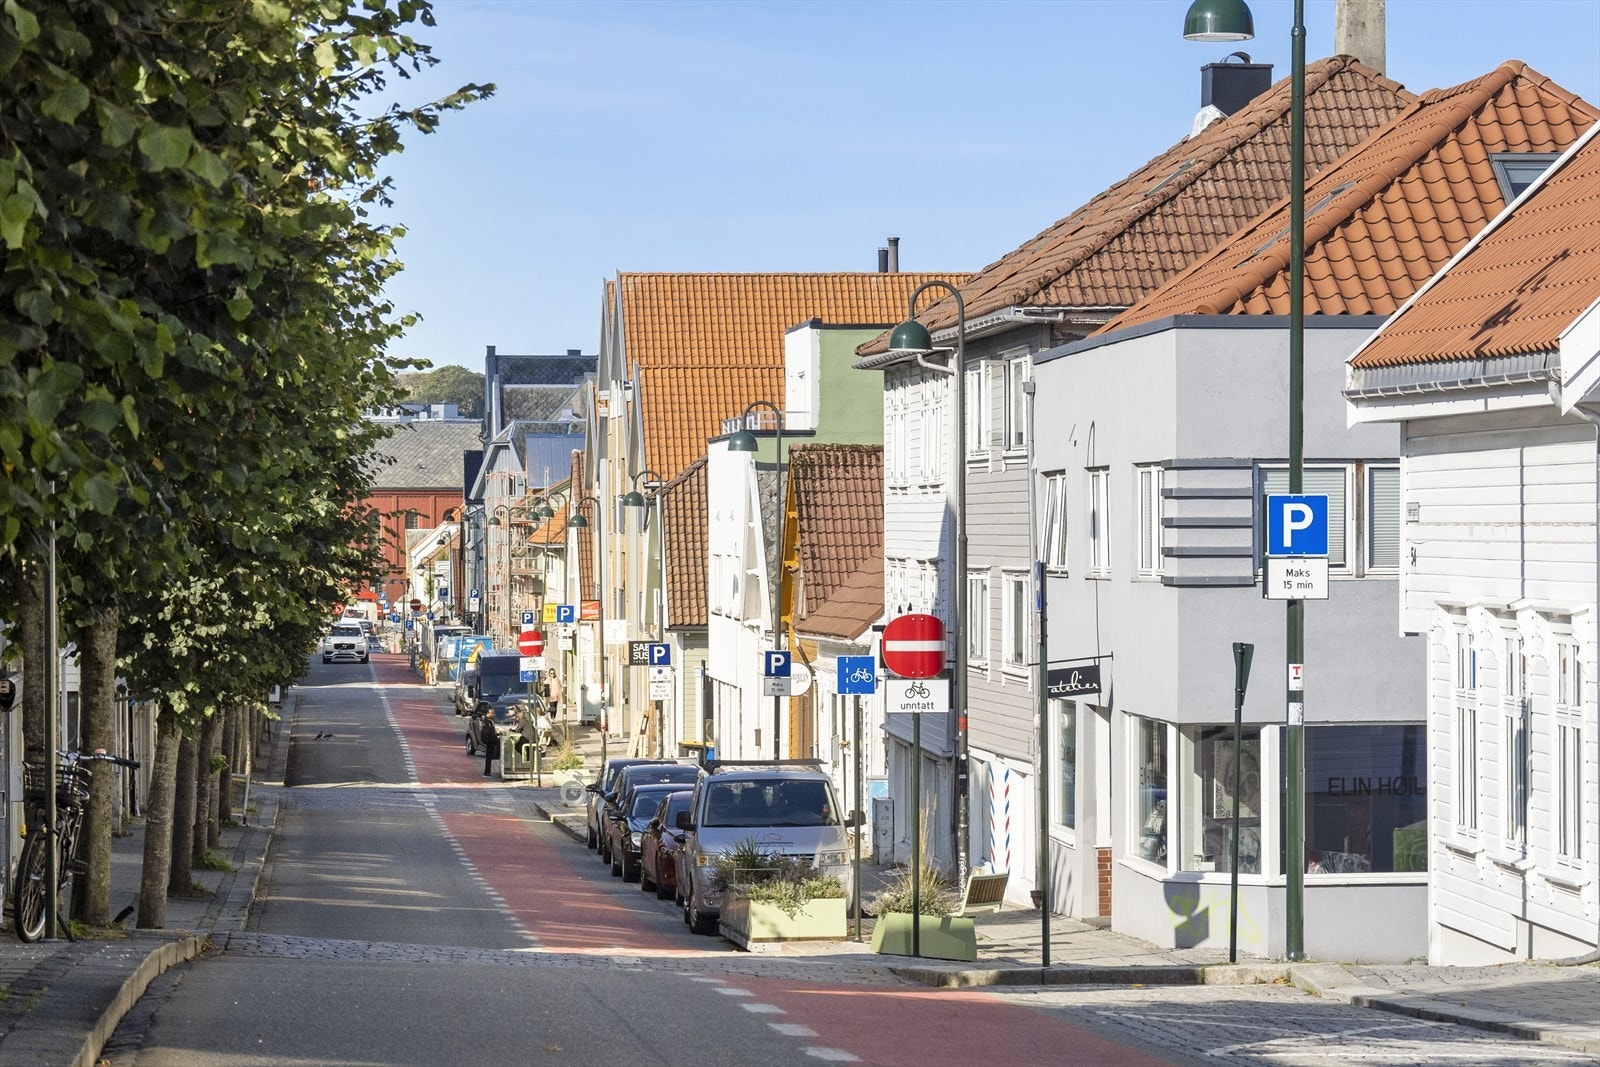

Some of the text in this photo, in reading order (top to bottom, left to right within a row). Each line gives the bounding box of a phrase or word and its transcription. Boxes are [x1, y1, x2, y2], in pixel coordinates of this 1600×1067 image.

[1283, 503, 1314, 547] P
[1285, 568, 1311, 577] Maks
[1283, 580, 1314, 589] 15 min
[524, 613, 531, 623] P
[561, 607, 570, 621] P
[653, 646, 666, 664] P
[771, 653, 785, 674] P
[1048, 670, 1099, 693] atelier
[900, 701, 935, 710] unntatt
[1328, 777, 1372, 796] ELIN
